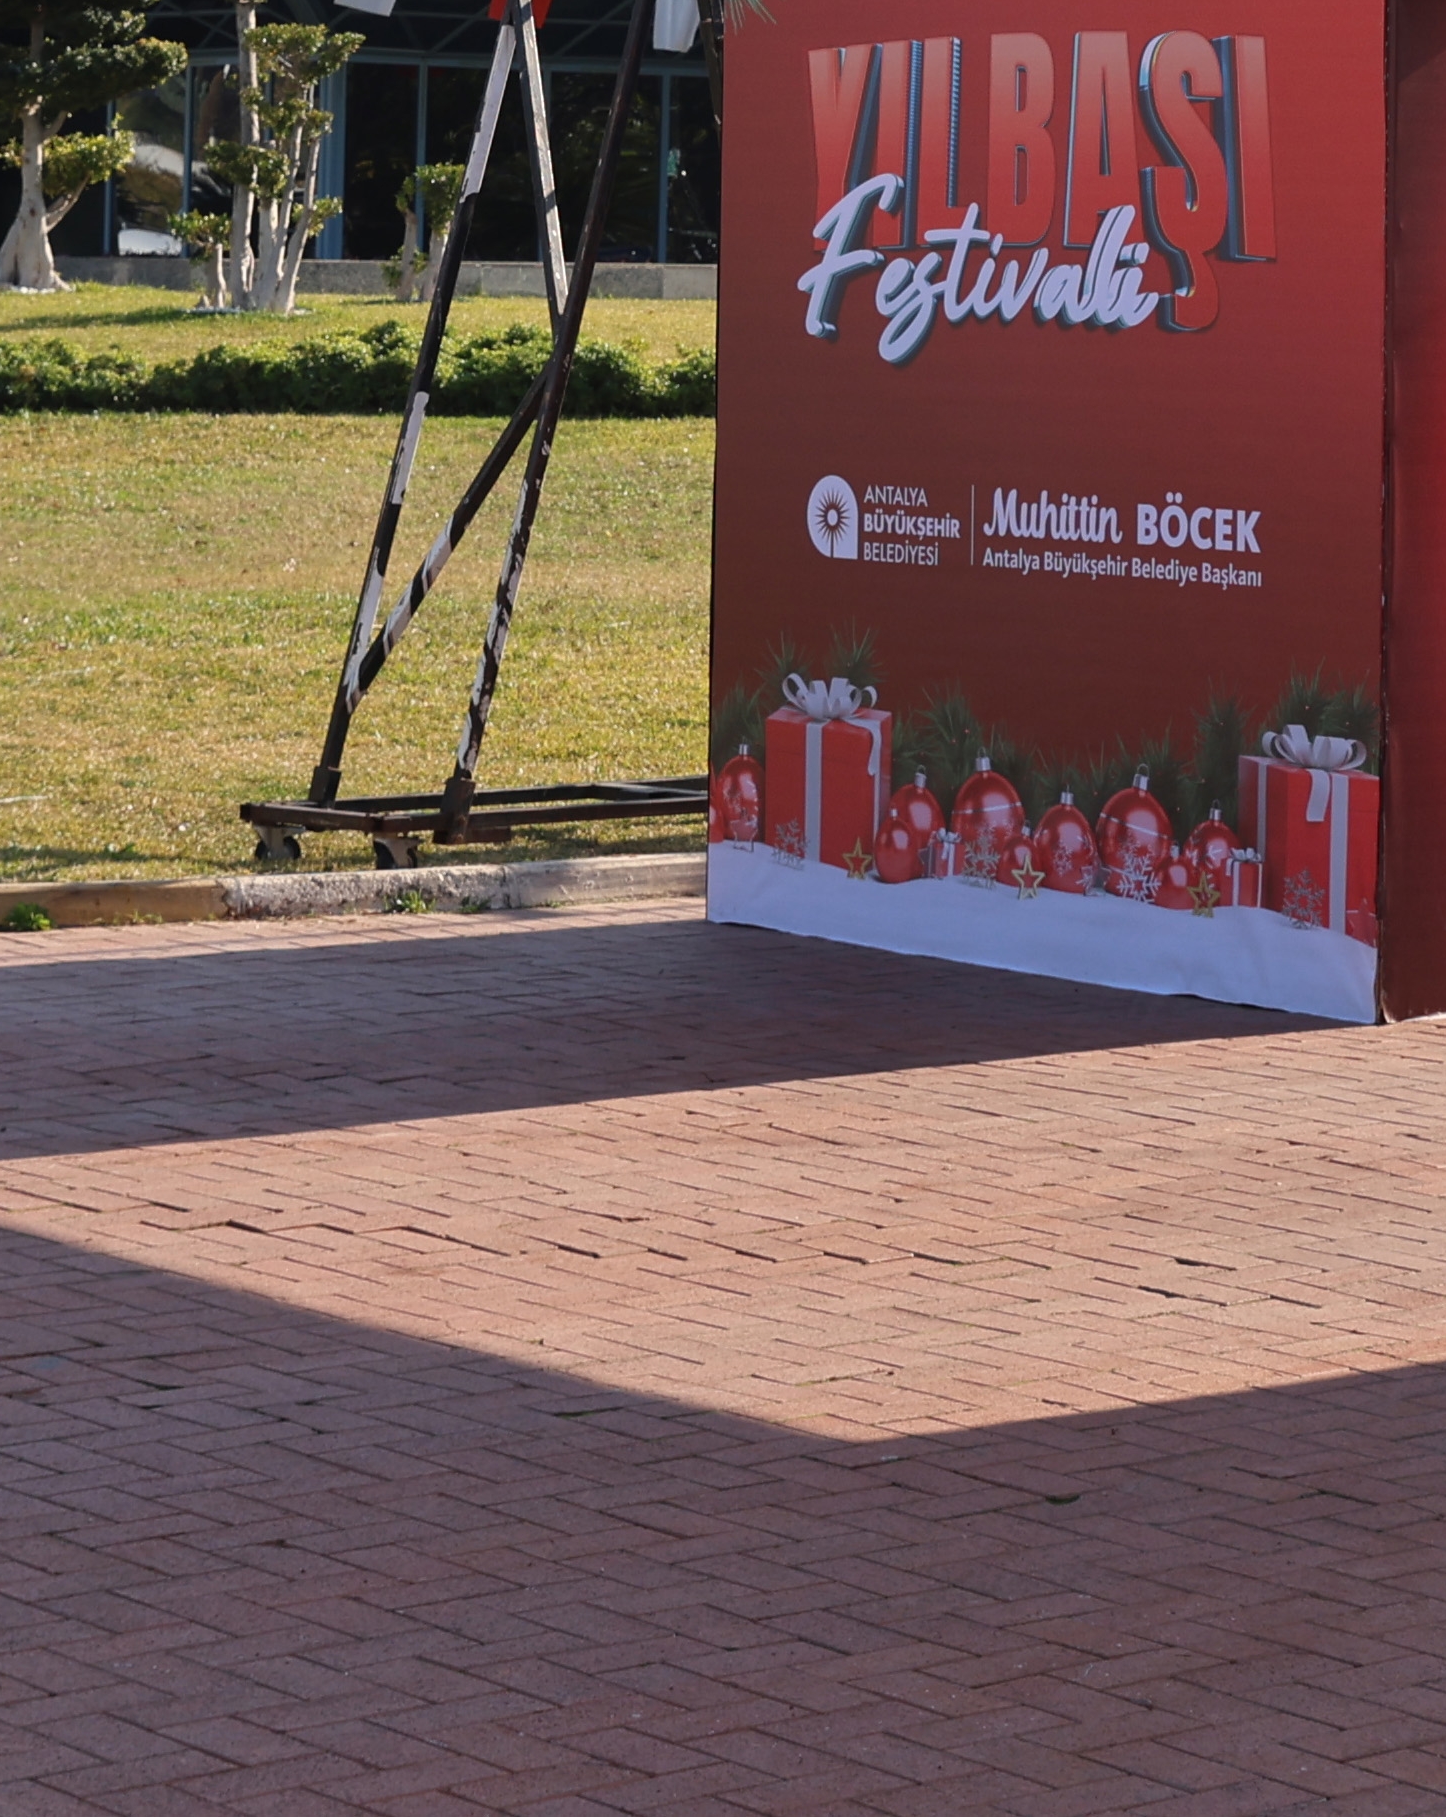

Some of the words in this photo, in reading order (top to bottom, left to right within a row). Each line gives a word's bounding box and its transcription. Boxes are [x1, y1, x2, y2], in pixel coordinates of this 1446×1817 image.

[808, 30, 1276, 331] YILBAŞI
[798, 173, 1159, 363] Festivali
[863, 485, 928, 507] ANTALYA
[864, 509, 961, 540] BÜYÜKŞEHİR
[983, 487, 1123, 544] Muhittin
[1137, 492, 1261, 554] BÖCEK
[863, 540, 939, 566] BELEDİYESİ
[983, 547, 1040, 575] Antalya
[1044, 551, 1128, 580] Büyükşehir
[1131, 558, 1197, 587] Belediye
[1201, 562, 1262, 590] Başkanı
